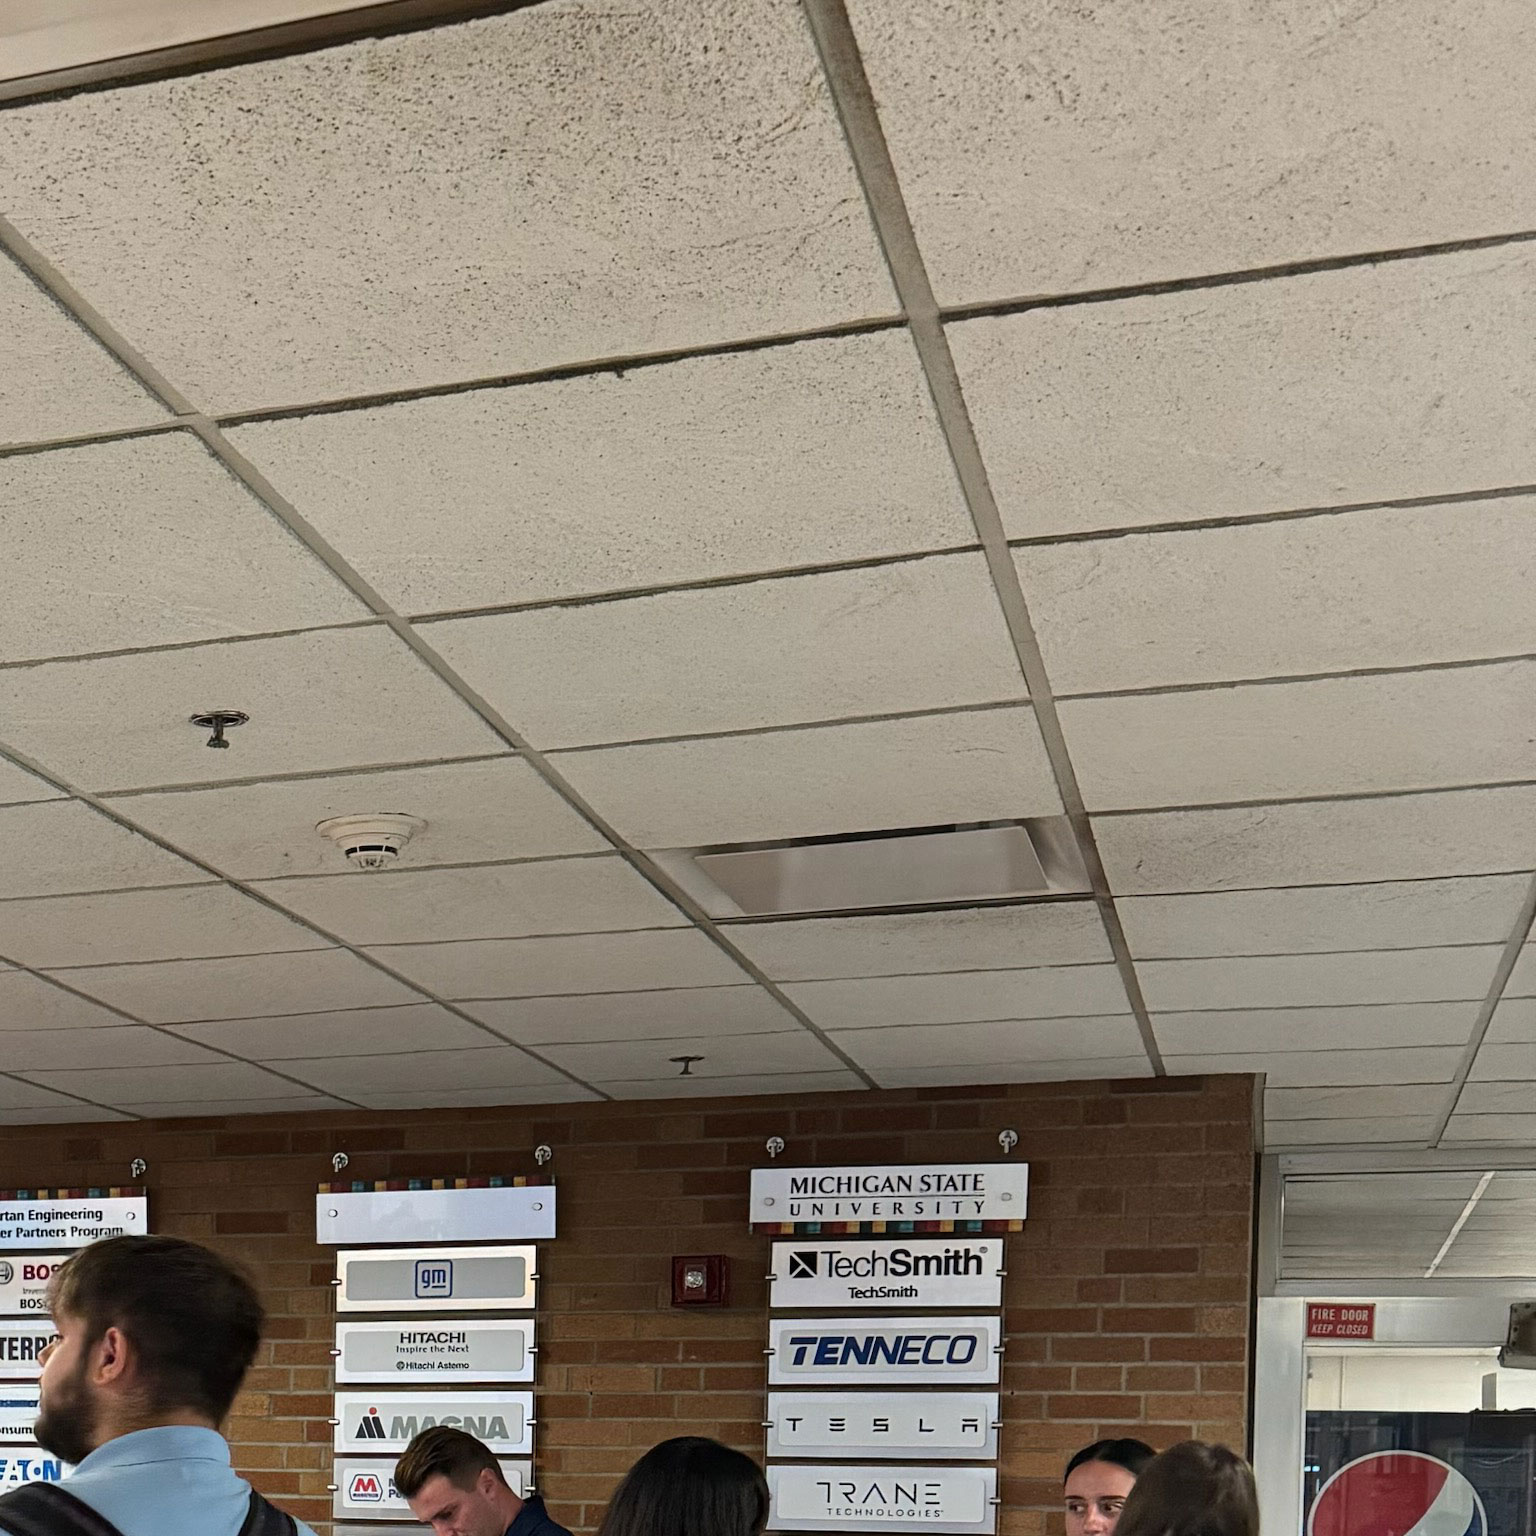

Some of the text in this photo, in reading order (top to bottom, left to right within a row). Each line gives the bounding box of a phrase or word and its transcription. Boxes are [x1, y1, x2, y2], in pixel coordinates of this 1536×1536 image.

[790, 1173, 985, 1194] MICHIGAN STATE
[790, 1200, 985, 1216] UNIVERSITY
[28, 1208, 103, 1223] Engineering
[15, 1226, 66, 1239] Partners
[70, 1226, 123, 1238] Program
[421, 1269, 446, 1289] gm
[848, 1286, 918, 1299] TechSmith
[1312, 1308, 1369, 1321] FIRE DOOR
[1312, 1324, 1368, 1334] KEEP CLOSED
[400, 1333, 466, 1343] HITACHI
[396, 1345, 469, 1354] Inspire the Next
[790, 1335, 978, 1365] TENNECO
[405, 1361, 470, 1370] Hitachi Astemo
[786, 1418, 979, 1432] TESLA
[816, 1482, 941, 1504] TRANE
[827, 1508, 941, 1517] TECHNOLOGIES
